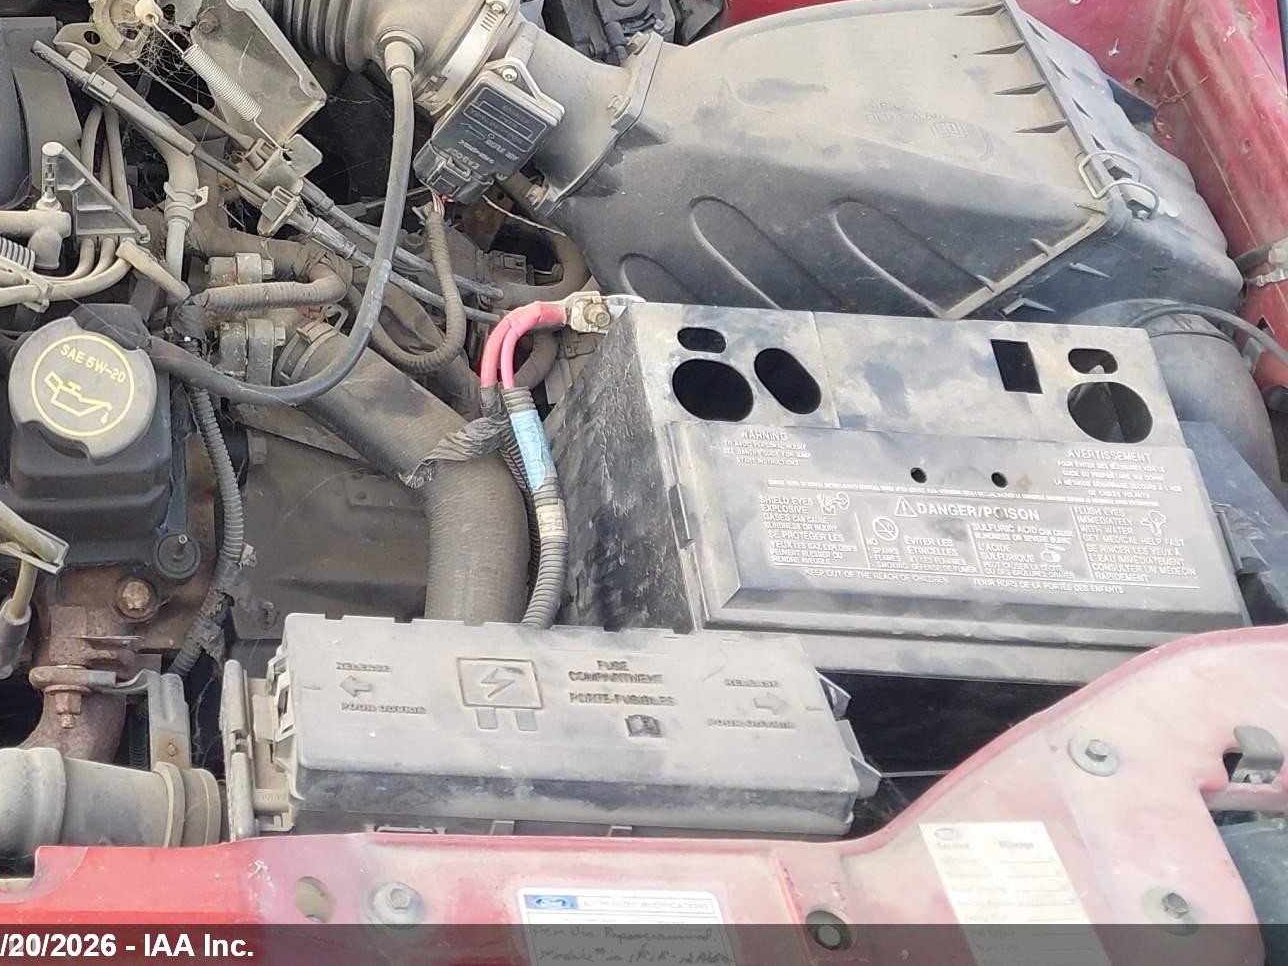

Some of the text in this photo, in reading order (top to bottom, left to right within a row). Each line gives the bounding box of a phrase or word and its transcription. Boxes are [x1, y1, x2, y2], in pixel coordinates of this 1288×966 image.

[60, 344, 127, 383] SAE 5W-20
[743, 430, 789, 441] WARNING
[1068, 449, 1151, 462] AVERTISSEMENT
[759, 496, 814, 506] SHIELD EYES
[761, 504, 809, 514] EXPLOSIVE
[917, 502, 1040, 521] DANGER/POISON
[1074, 506, 1125, 517] FLUSH EYES
[972, 523, 1015, 533] SULFURIC
[1017, 525, 1037, 534] ACID
[865, 538, 878, 546] NO
[980, 552, 1036, 562] SULFURIQUE
[597, 660, 630, 671] FUSE
